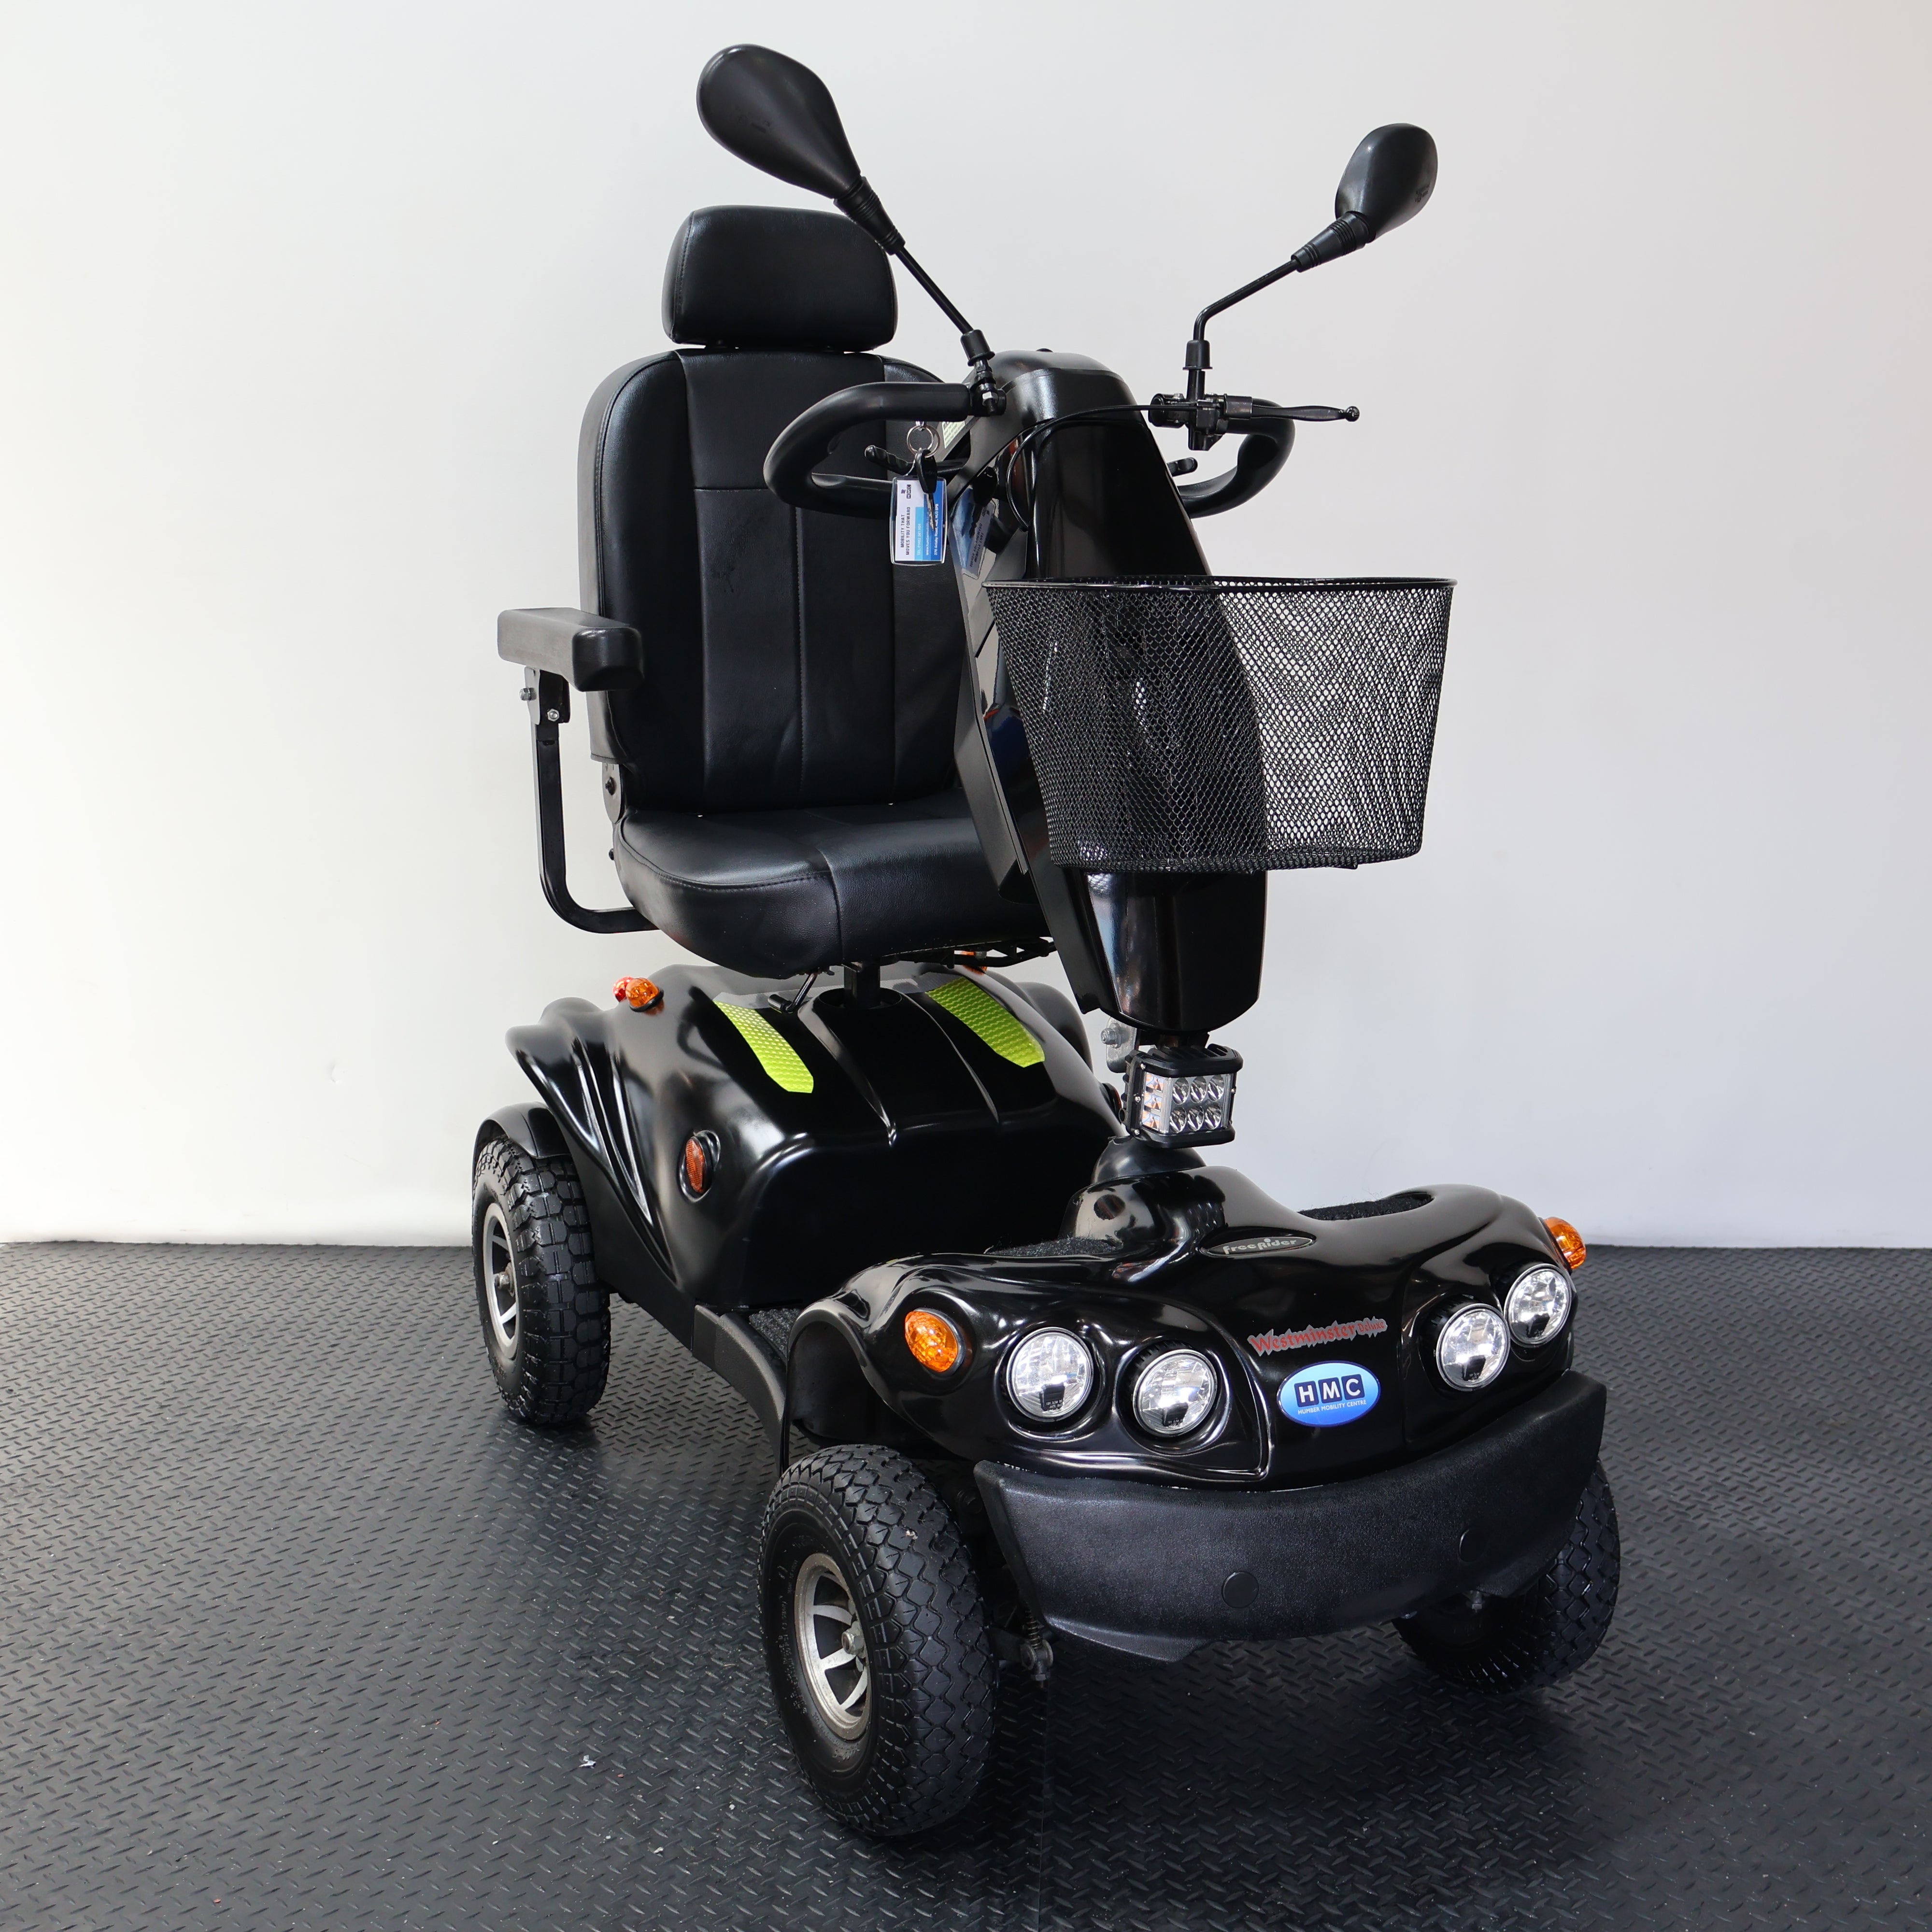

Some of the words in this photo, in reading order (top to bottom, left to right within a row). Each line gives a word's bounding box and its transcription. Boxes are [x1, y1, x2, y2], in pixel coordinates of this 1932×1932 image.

[1250, 1324, 1355, 1352] Westminster
[1358, 1321, 1385, 1333] Deluxe
[1298, 1378, 1361, 1403] HMC
[1298, 1406, 1320, 1415] HUMBER
[1321, 1402, 1345, 1411] MOBILITY
